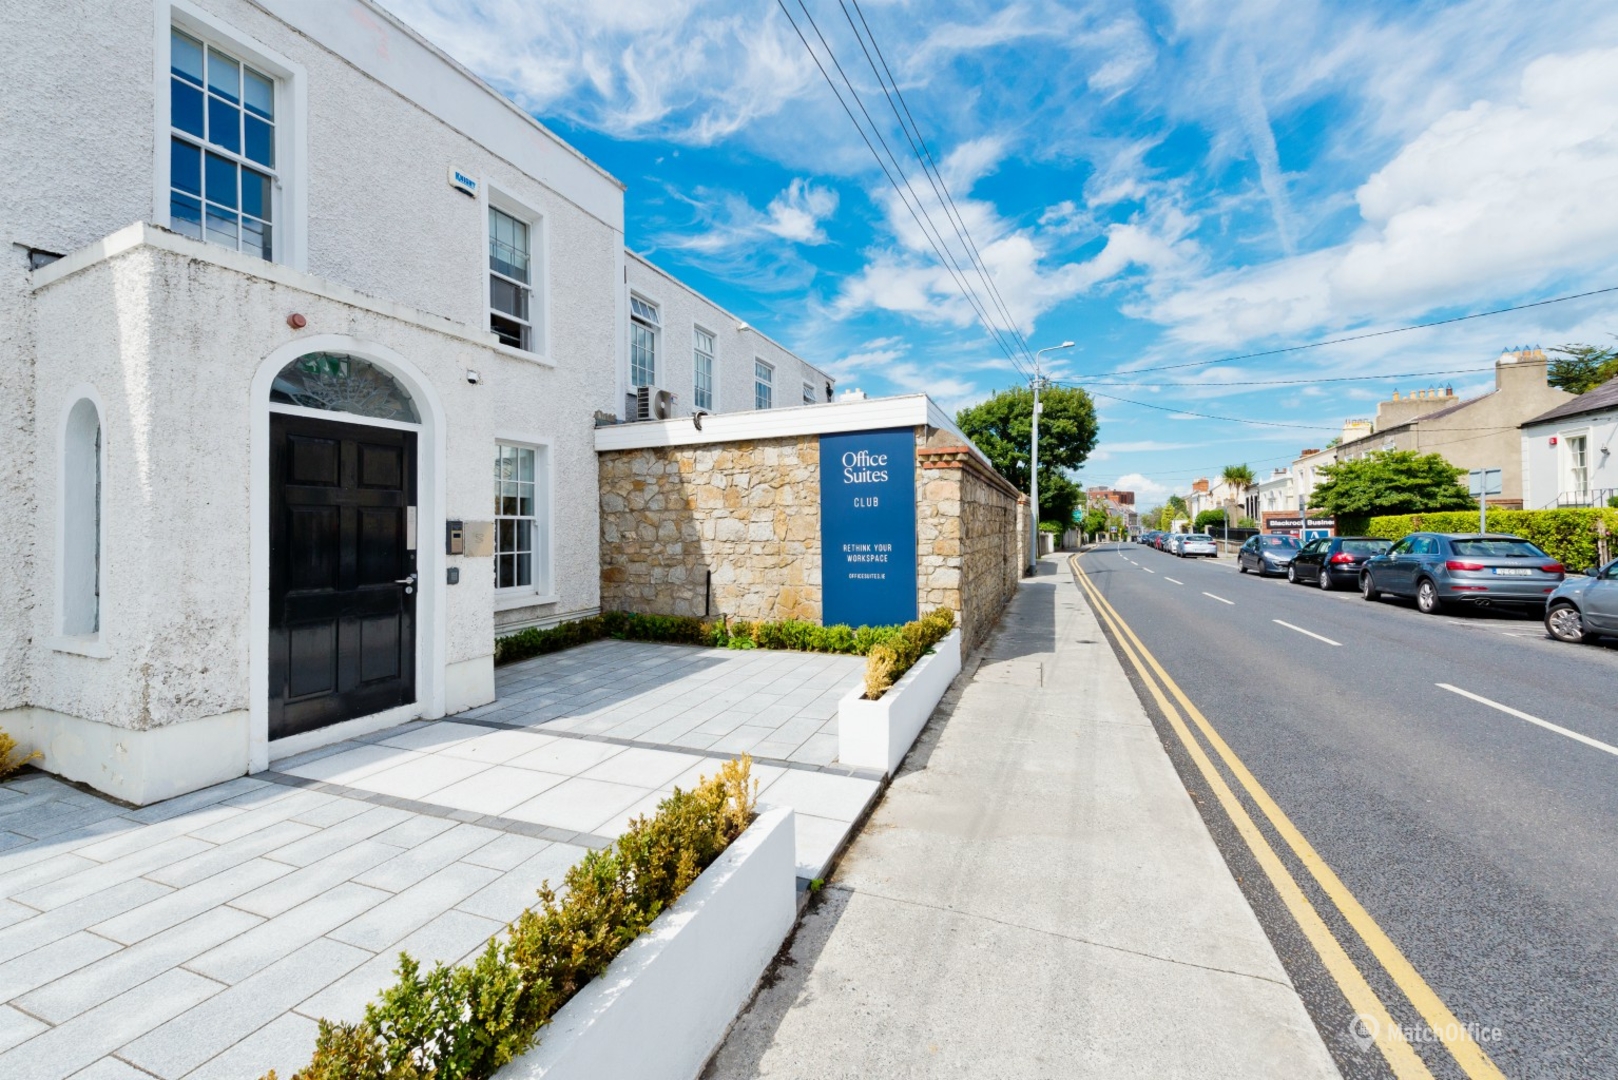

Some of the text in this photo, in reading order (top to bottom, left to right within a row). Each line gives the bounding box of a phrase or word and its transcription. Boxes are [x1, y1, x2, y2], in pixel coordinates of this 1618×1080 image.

[842, 450, 888, 468] Office
[843, 467, 889, 484] Suites
[853, 497, 879, 508] CLUB
[843, 543, 892, 553] RETHINK YOUR
[847, 554, 888, 563] WORKSPACE
